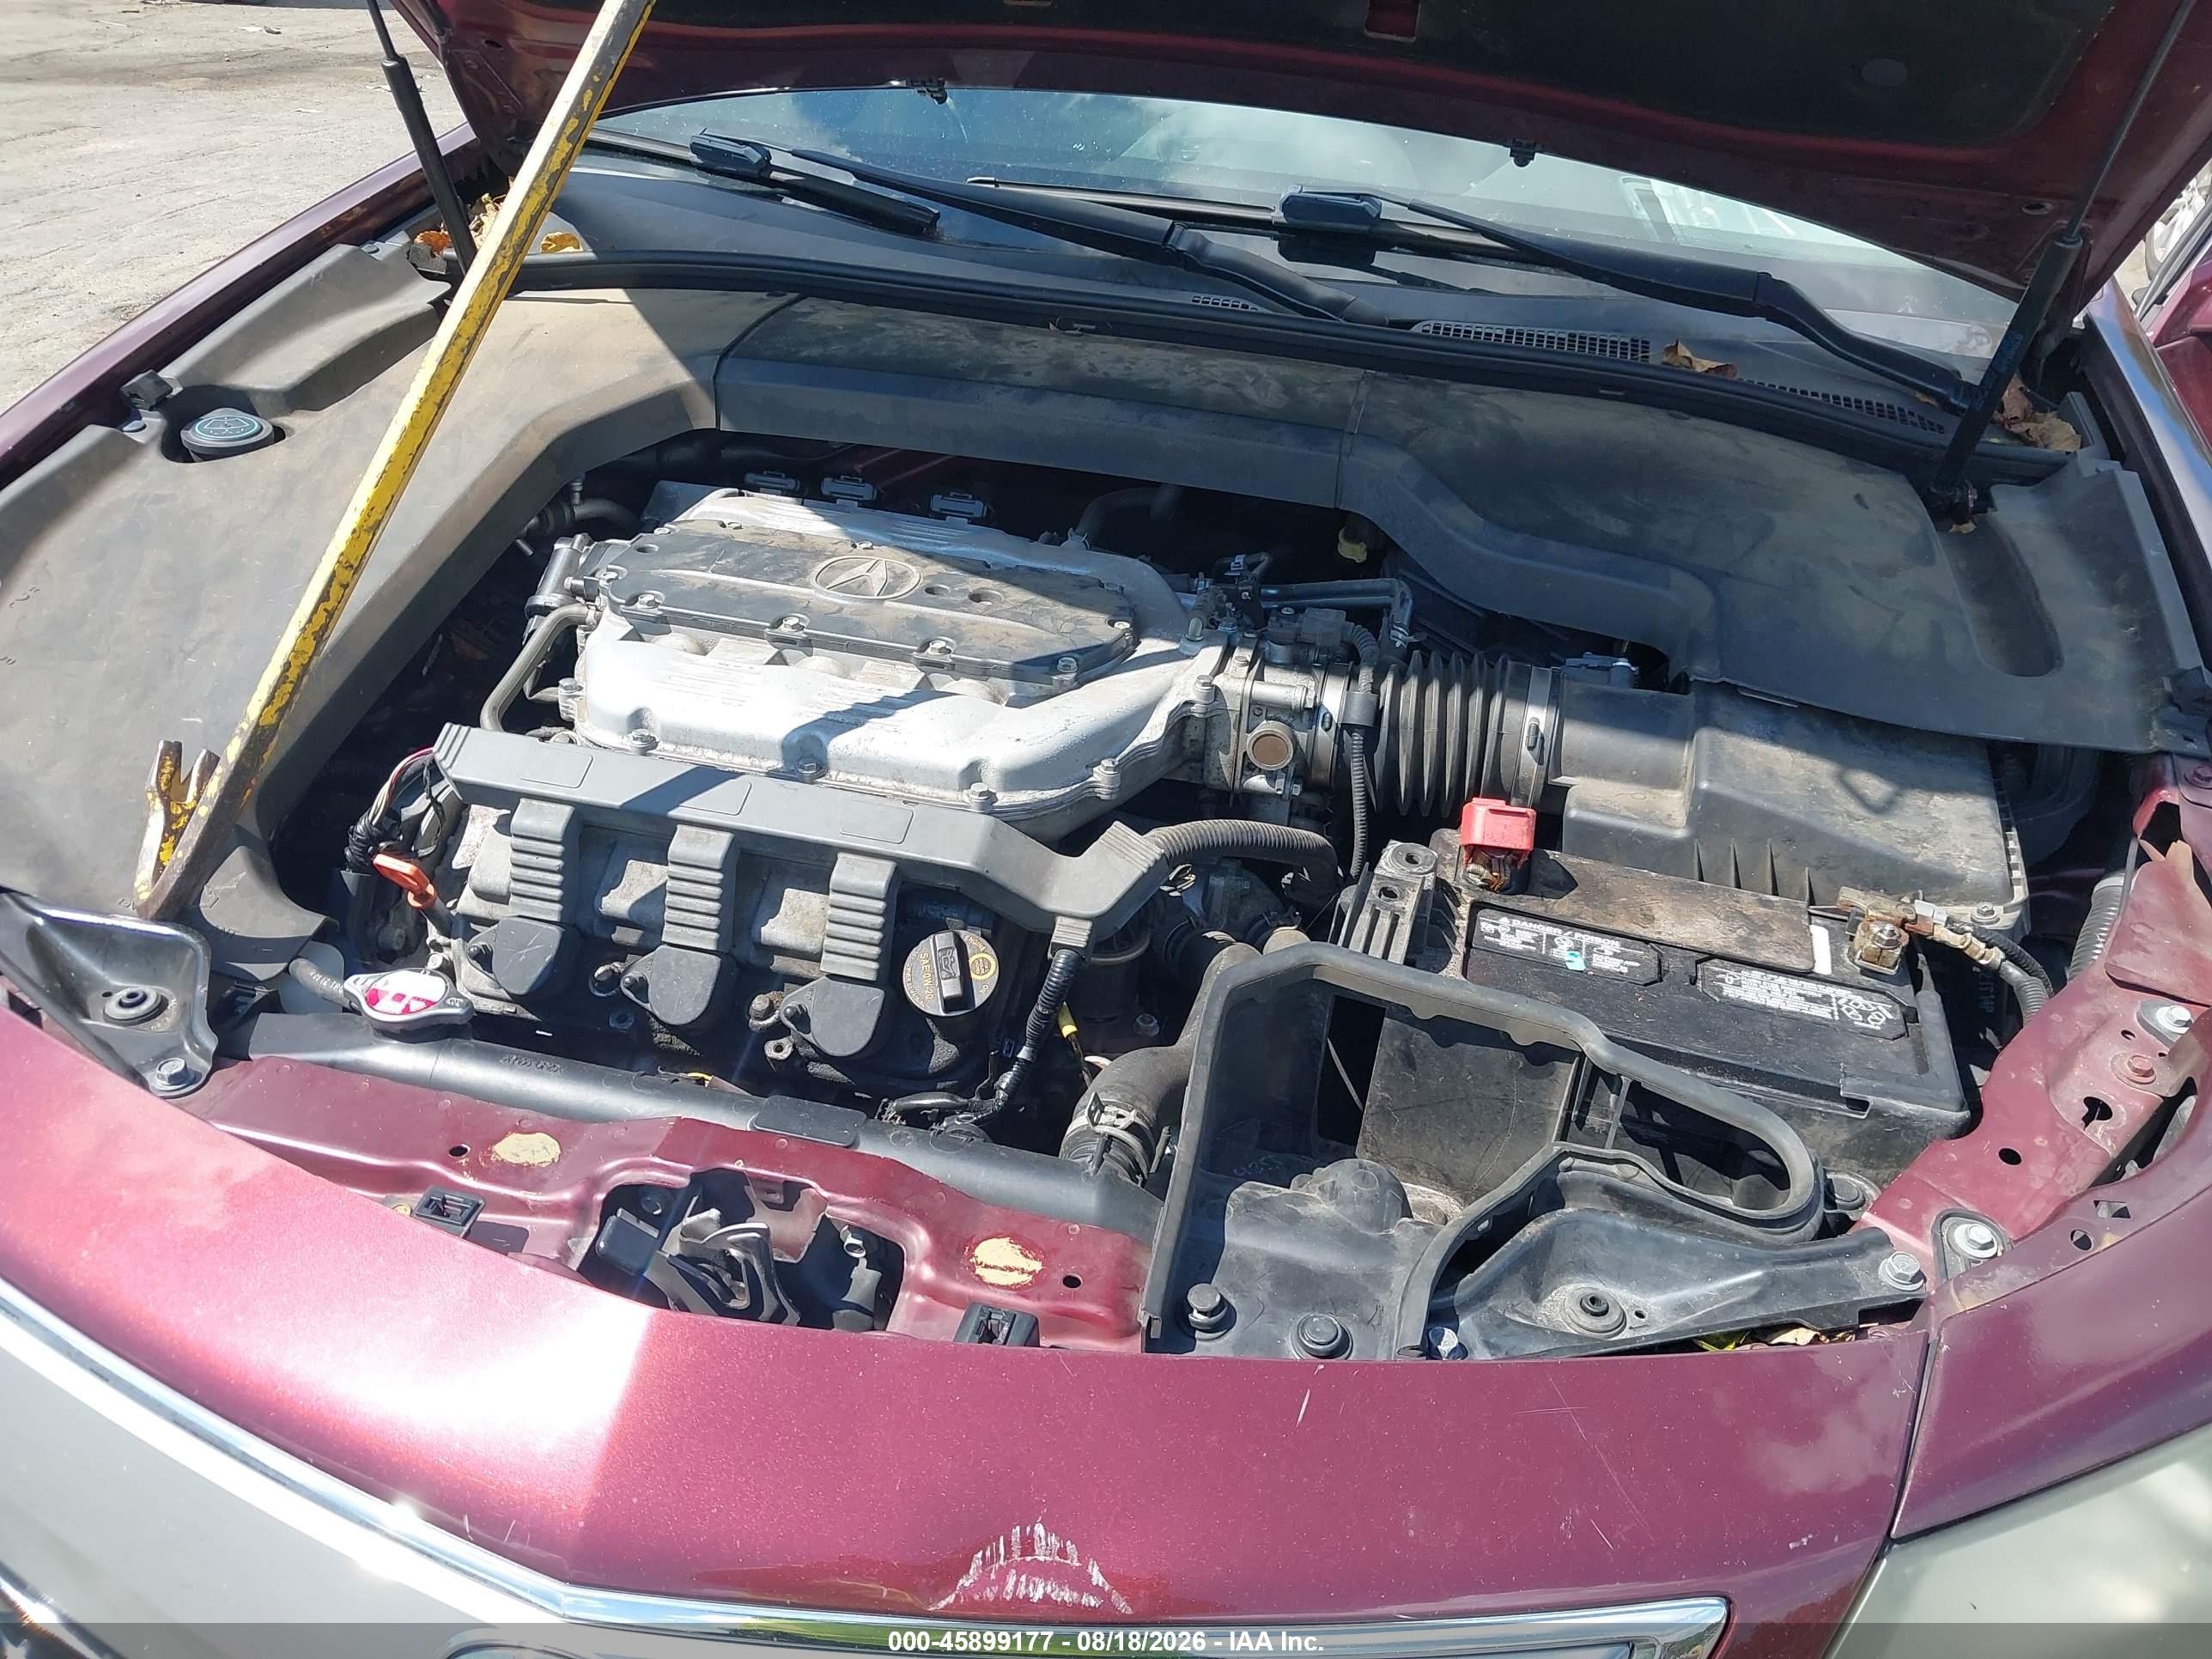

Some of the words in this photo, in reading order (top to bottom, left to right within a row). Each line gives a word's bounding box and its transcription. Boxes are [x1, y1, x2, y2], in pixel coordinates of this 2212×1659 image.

[965, 935, 987, 951] ENGINE
[1512, 920, 1563, 935] DANGER
[1575, 933, 1620, 947] POISON
[920, 952, 932, 972] SAE
[922, 973, 935, 1000] 0W-20
